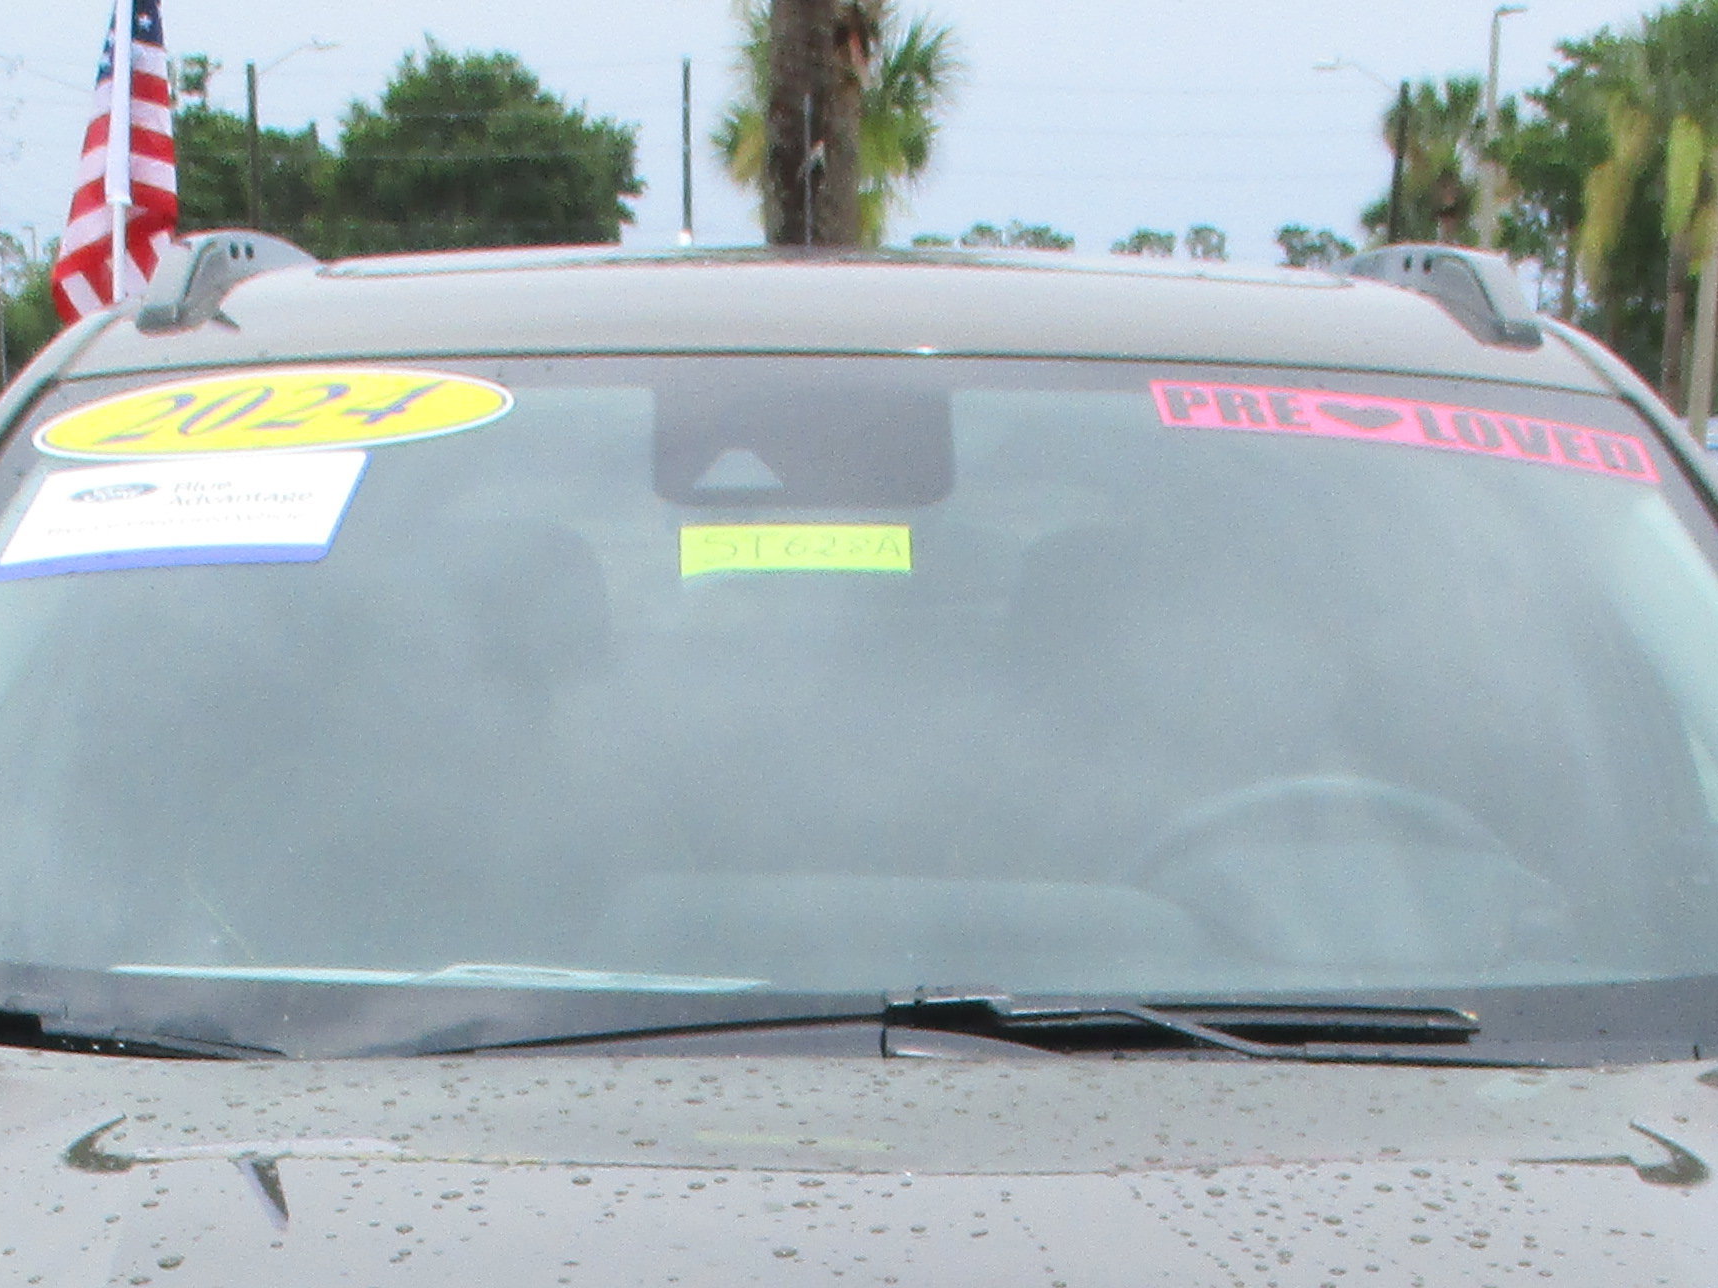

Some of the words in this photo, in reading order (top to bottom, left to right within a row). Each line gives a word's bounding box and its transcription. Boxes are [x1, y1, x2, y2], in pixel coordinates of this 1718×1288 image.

[94, 382, 449, 445] 2024
[1162, 386, 1311, 427] PRE
[1417, 406, 1647, 473] LOVED
